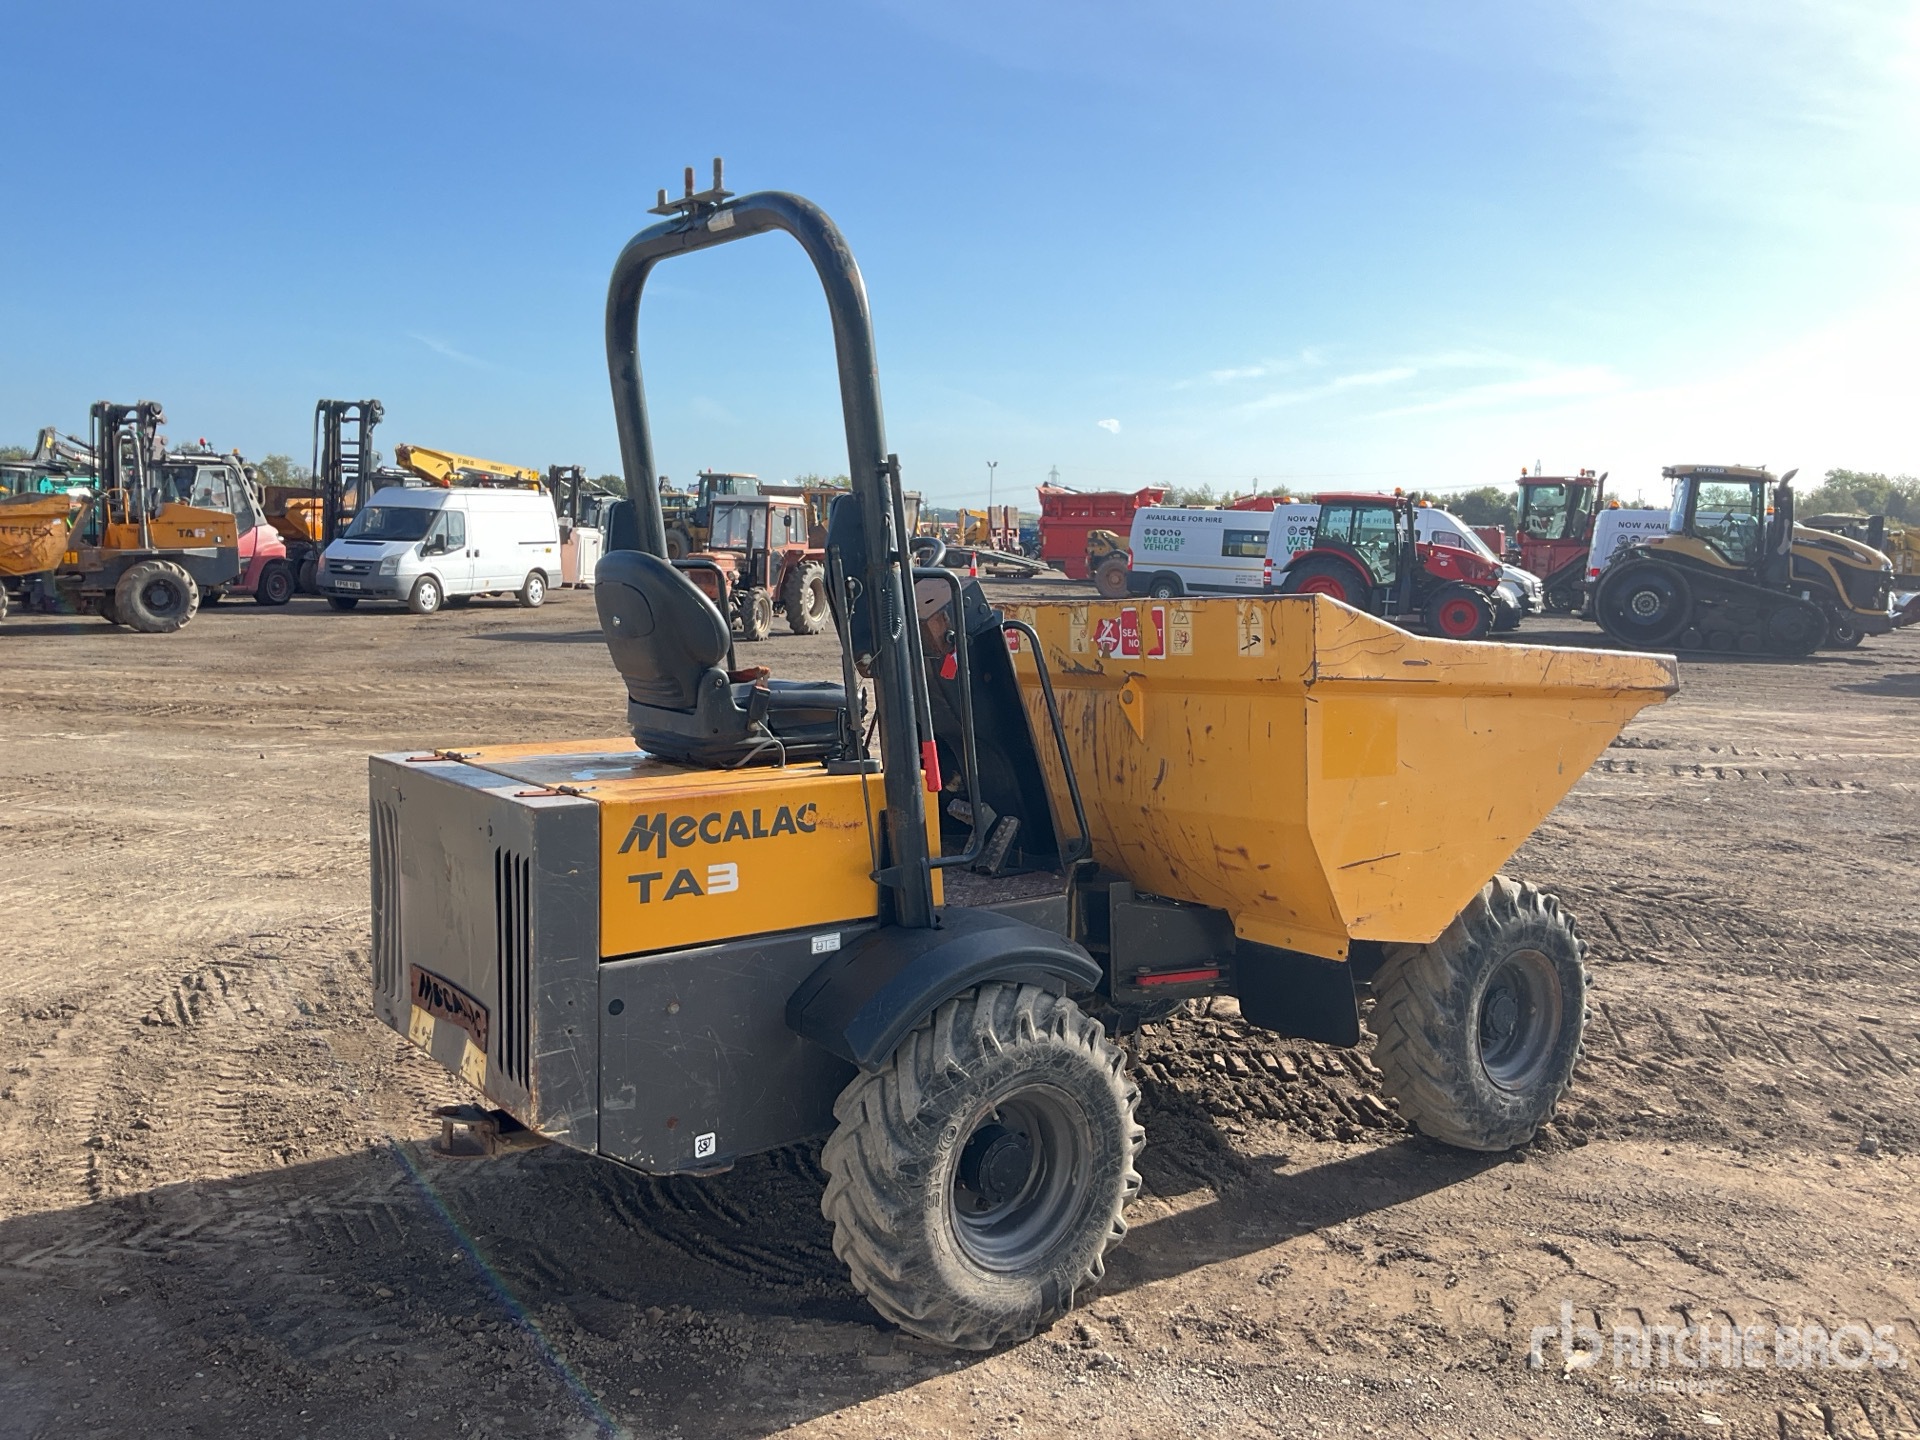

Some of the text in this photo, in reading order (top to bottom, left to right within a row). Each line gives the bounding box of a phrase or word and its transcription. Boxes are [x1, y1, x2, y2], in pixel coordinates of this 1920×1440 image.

[1146, 514, 1186, 522] AVAILABLE
[1618, 521, 1642, 529] NOW
[0, 526, 54, 537] TEREX
[177, 528, 206, 538] TA6
[1144, 536, 1186, 545] WELFARE
[1143, 543, 1180, 551] VEHICLE
[1122, 629, 1137, 637] SEA
[627, 862, 739, 904] TA3
